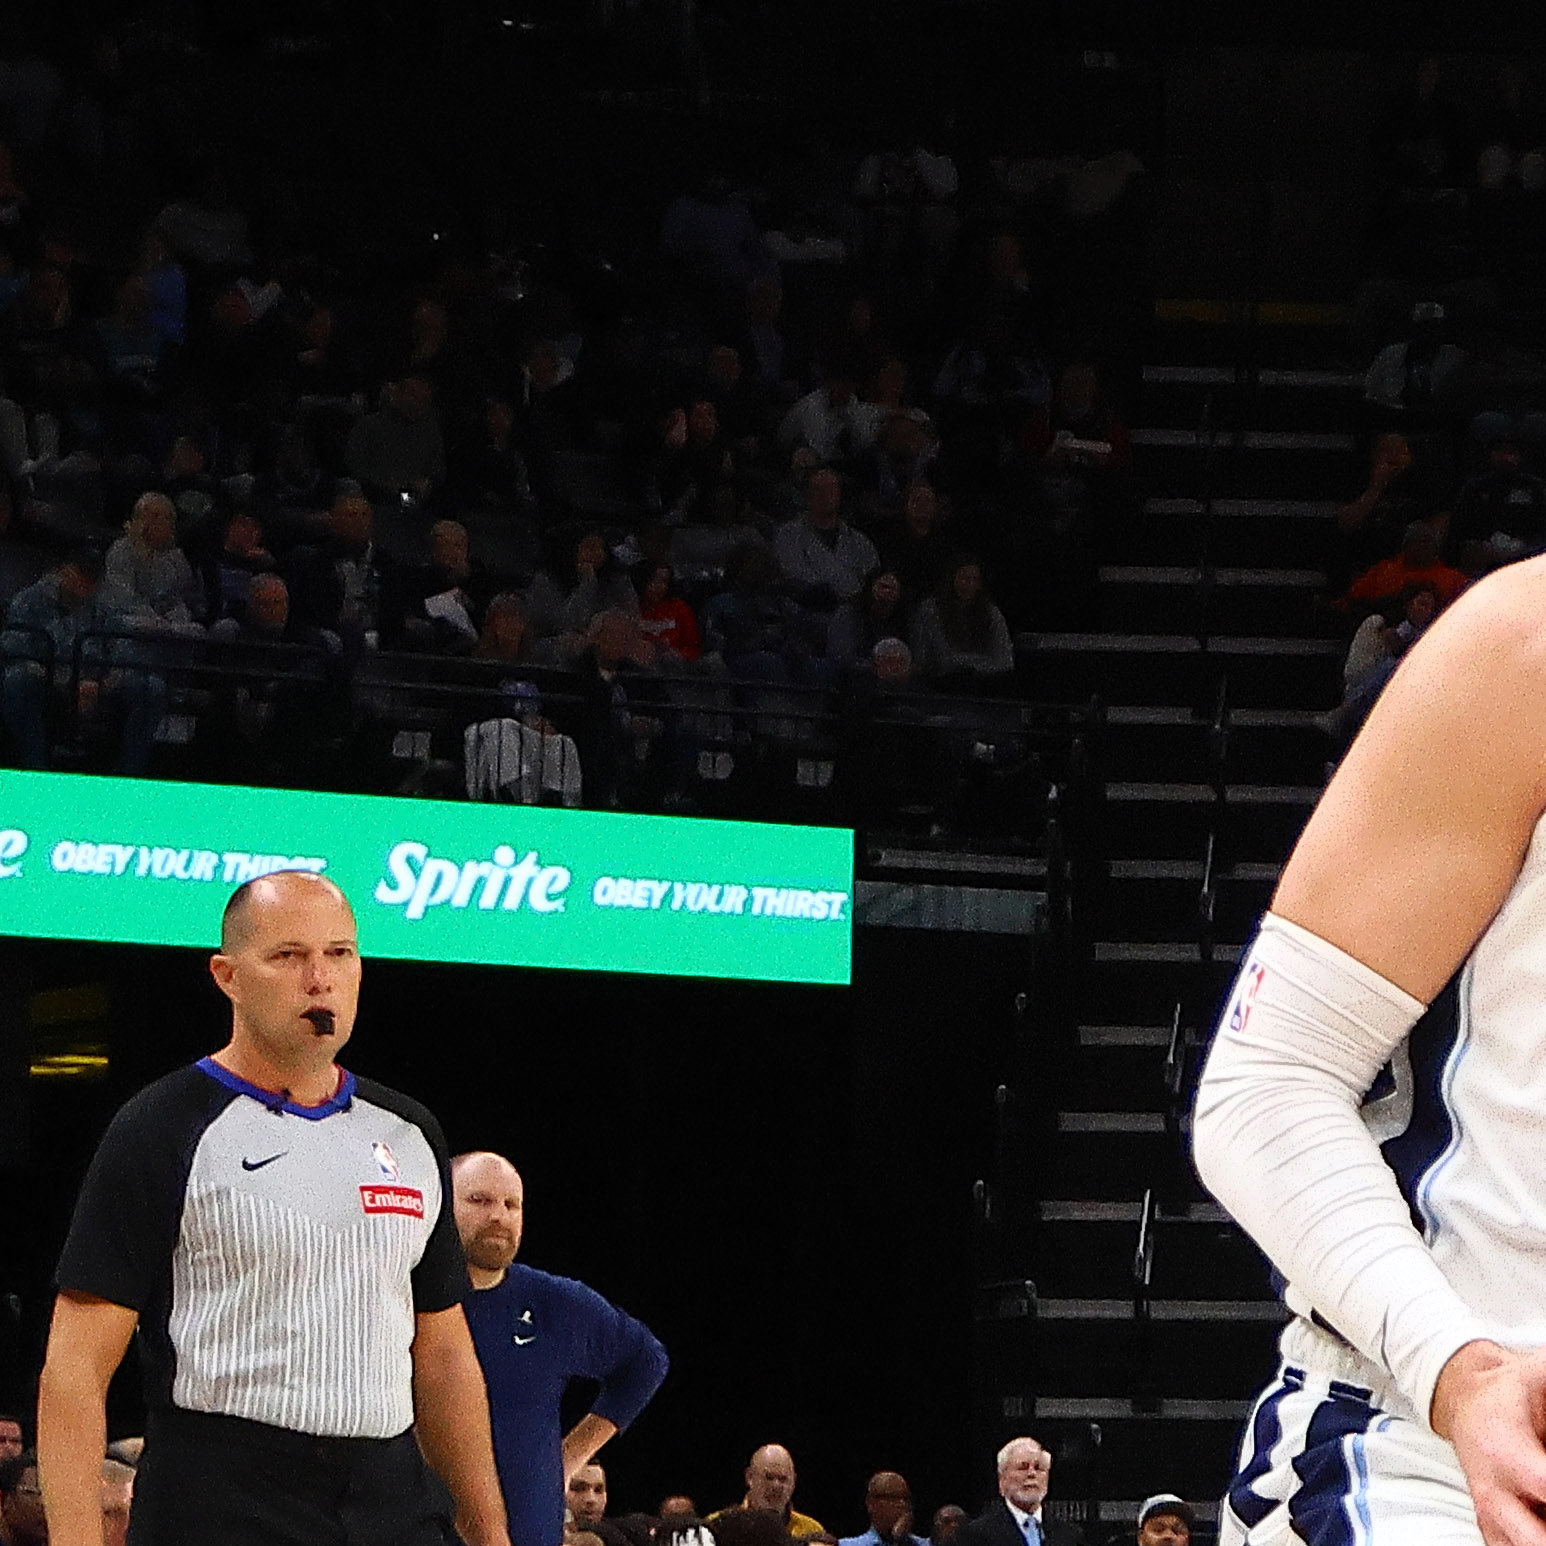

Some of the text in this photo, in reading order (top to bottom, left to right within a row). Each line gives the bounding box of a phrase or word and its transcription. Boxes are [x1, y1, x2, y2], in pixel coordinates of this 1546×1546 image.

[51, 840, 135, 876] OBEY
[135, 846, 219, 881] YOUR
[375, 840, 571, 920] Sprite
[593, 876, 847, 920] OBEY YOUR THIRST.
